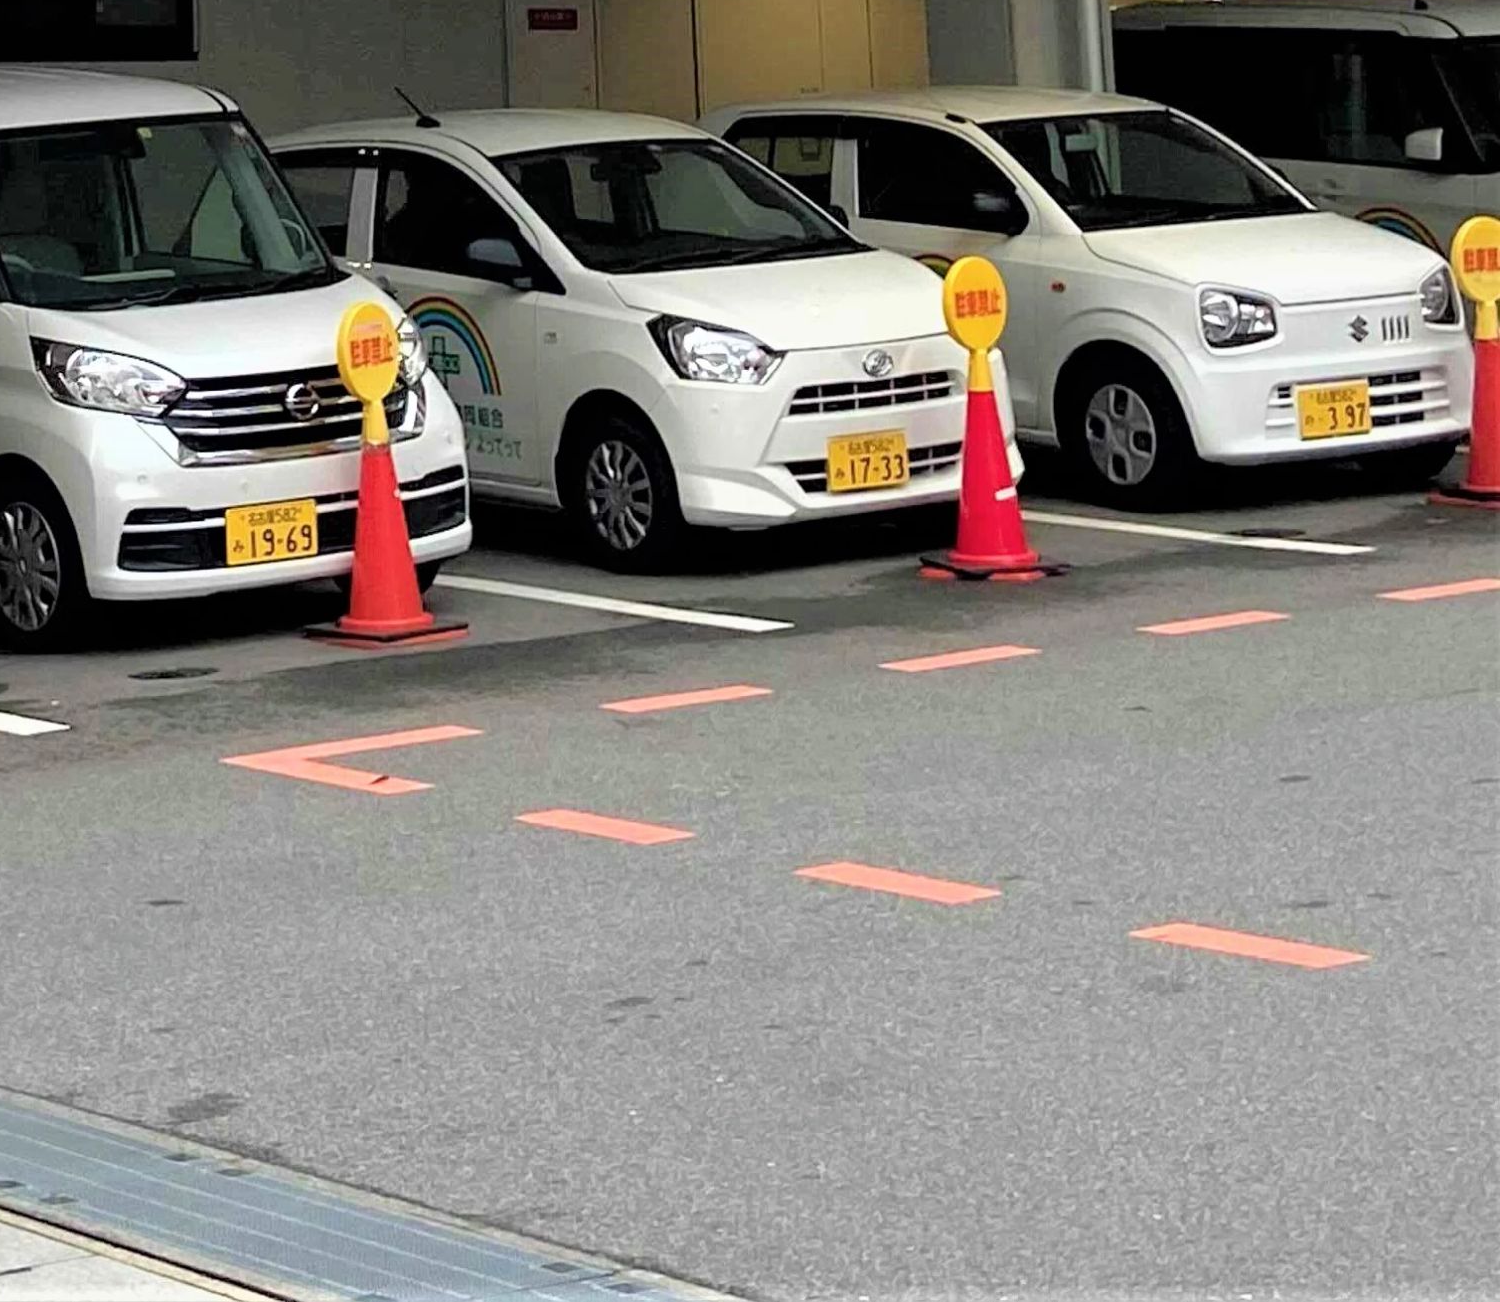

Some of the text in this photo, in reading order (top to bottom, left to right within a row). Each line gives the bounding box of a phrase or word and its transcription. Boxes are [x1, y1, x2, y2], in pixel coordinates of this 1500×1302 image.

[1463, 247, 1500, 273] 駐車禁
[955, 288, 1002, 319] 駐車禁止
[850, 453, 904, 485] 17-33
[250, 524, 313, 558] 19-69
